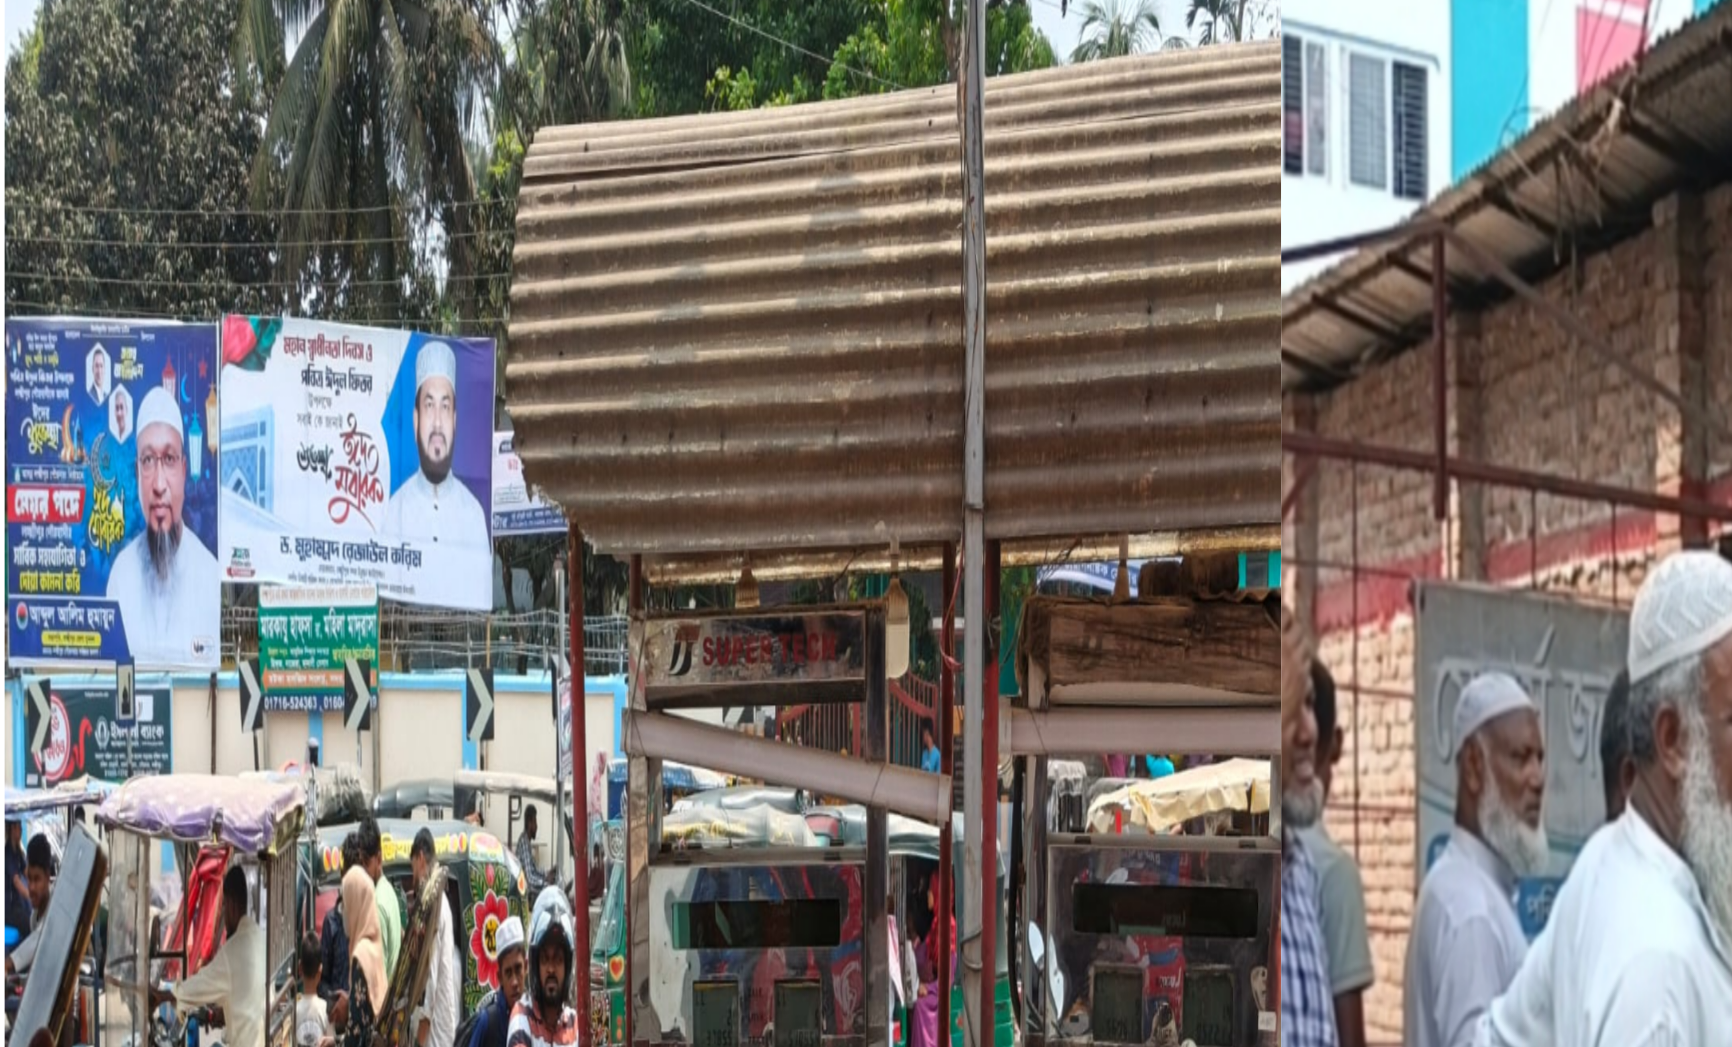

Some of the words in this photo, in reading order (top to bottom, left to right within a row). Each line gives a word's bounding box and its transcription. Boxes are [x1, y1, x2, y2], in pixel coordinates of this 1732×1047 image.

[283, 336, 306, 356] মহান
[307, 333, 340, 361] স্বাধীনতা
[343, 335, 364, 360] দিবস
[366, 344, 373, 362] ও
[301, 363, 323, 388] পবিত্র
[325, 365, 347, 396] ঈদুল
[349, 367, 373, 396] ফিতর
[294, 537, 340, 562] মুহাম্মদ
[342, 538, 388, 565] রেজাউল
[391, 541, 422, 571] করিম
[323, 606, 345, 642] মহিলা
[702, 632, 772, 666] SUPER
[780, 631, 837, 664] TECH
